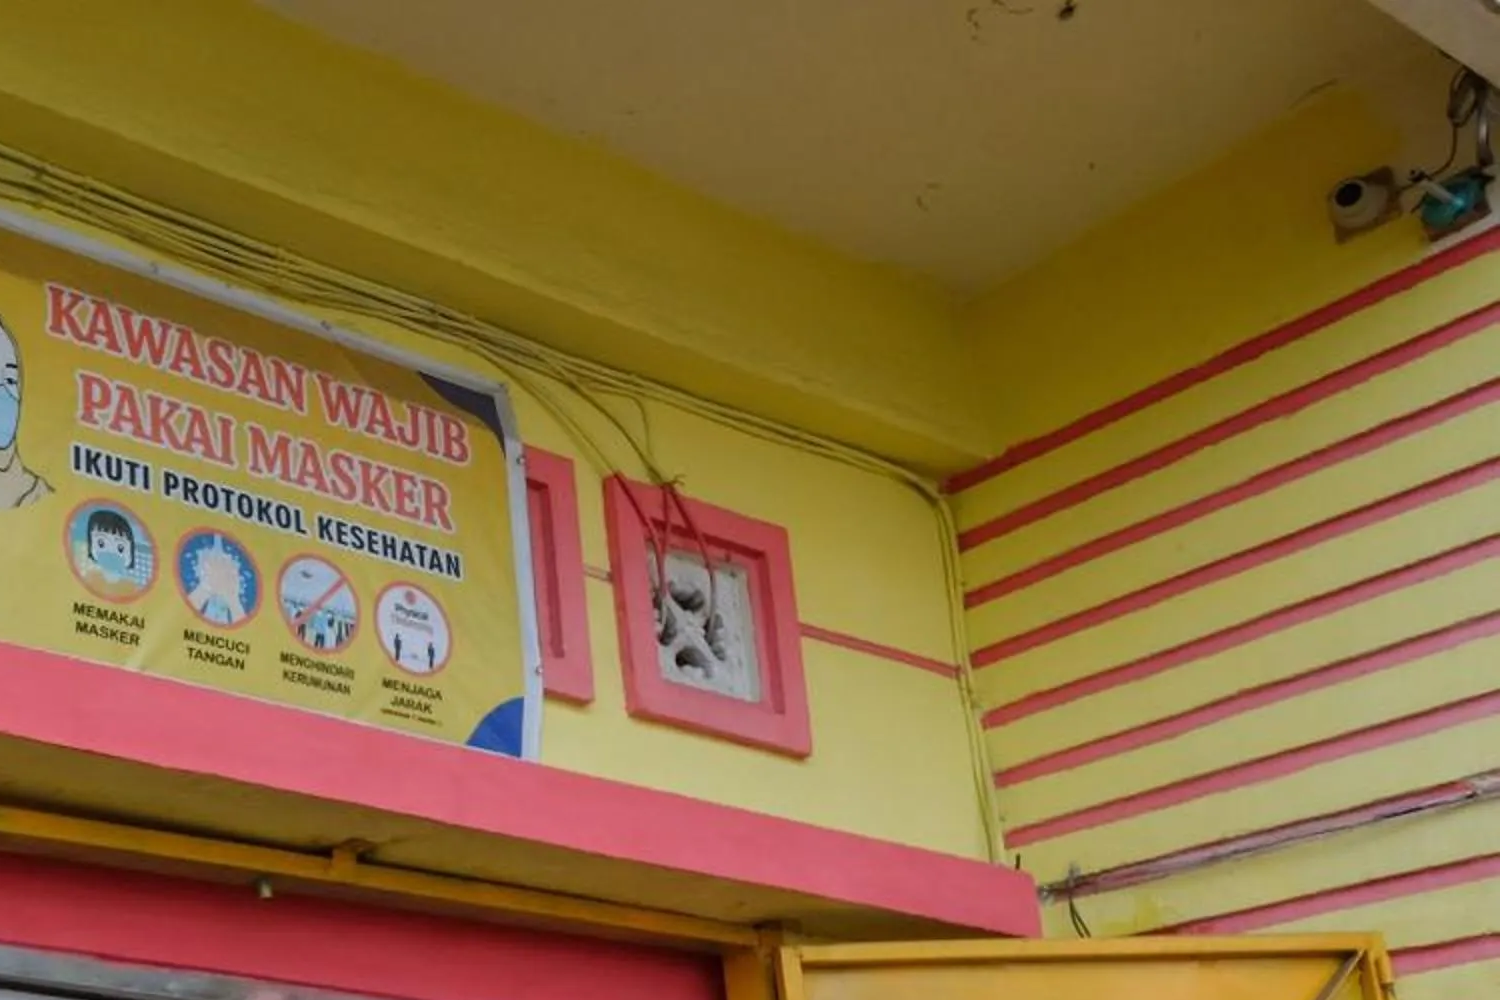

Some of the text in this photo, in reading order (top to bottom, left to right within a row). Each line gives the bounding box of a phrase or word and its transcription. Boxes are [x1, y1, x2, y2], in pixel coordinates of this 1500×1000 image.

[47, 285, 470, 463] KAWASAN WAJIB
[79, 374, 453, 531] PAKAI MASKER
[72, 446, 462, 578] IKUTI PROTOKOL KESEHATAN
[73, 602, 145, 630] MEMAKAI
[75, 621, 140, 647] MASKER
[183, 629, 250, 655] MENCUCI
[187, 648, 245, 671] TANGAN
[381, 677, 443, 701] MENJAGA
[390, 696, 432, 715] JARAK
